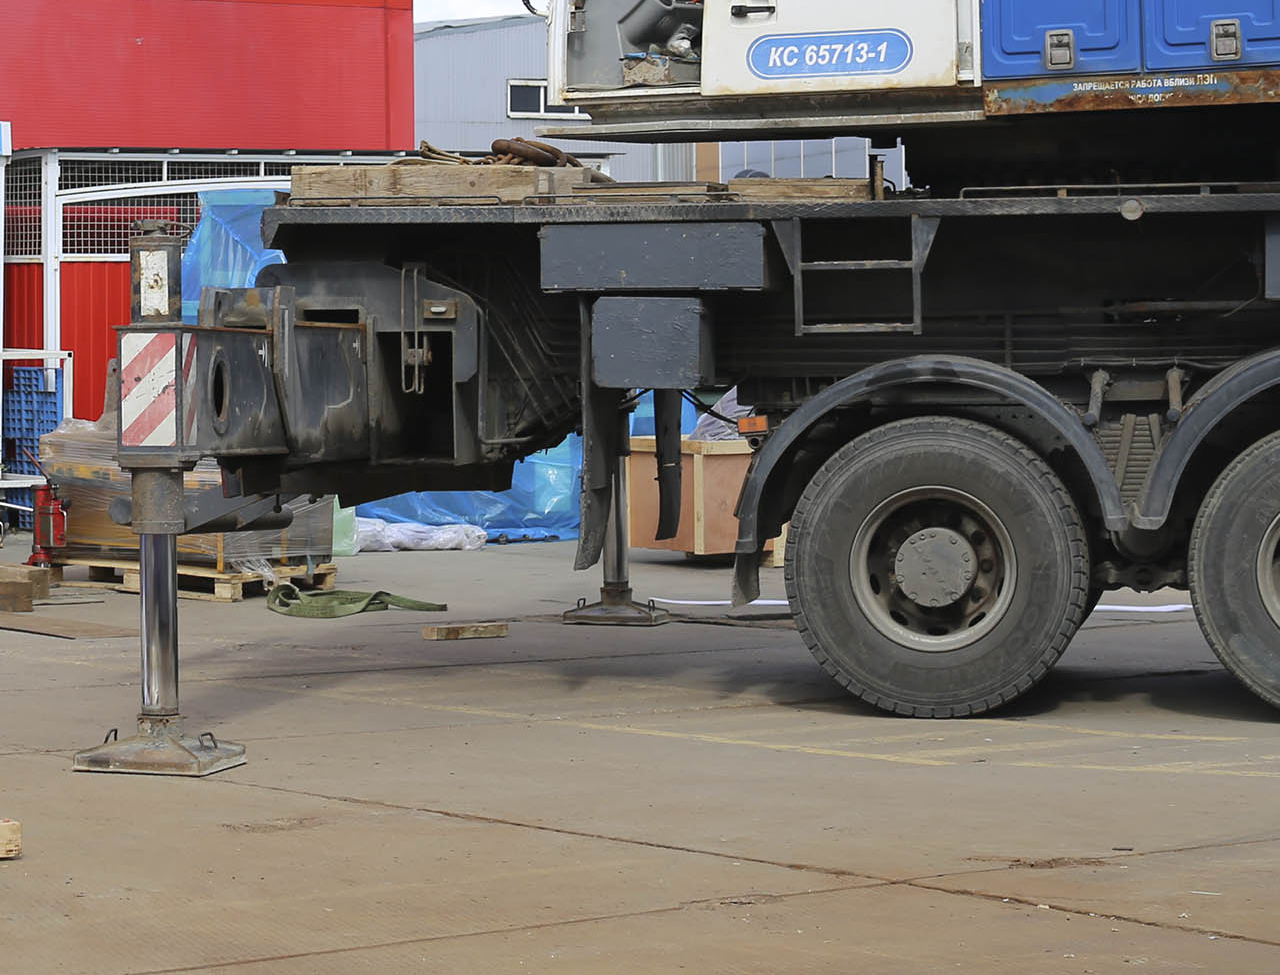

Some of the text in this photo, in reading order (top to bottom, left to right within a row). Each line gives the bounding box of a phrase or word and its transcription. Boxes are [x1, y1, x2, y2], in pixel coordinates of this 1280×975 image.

[768, 41, 889, 67] КС 65713-1
[1072, 81, 1130, 91] ЗАПРЕЩАЕТСЯ
[1130, 78, 1163, 89] РАБОТА
[1164, 76, 1195, 87] ВБЛИЗИ
